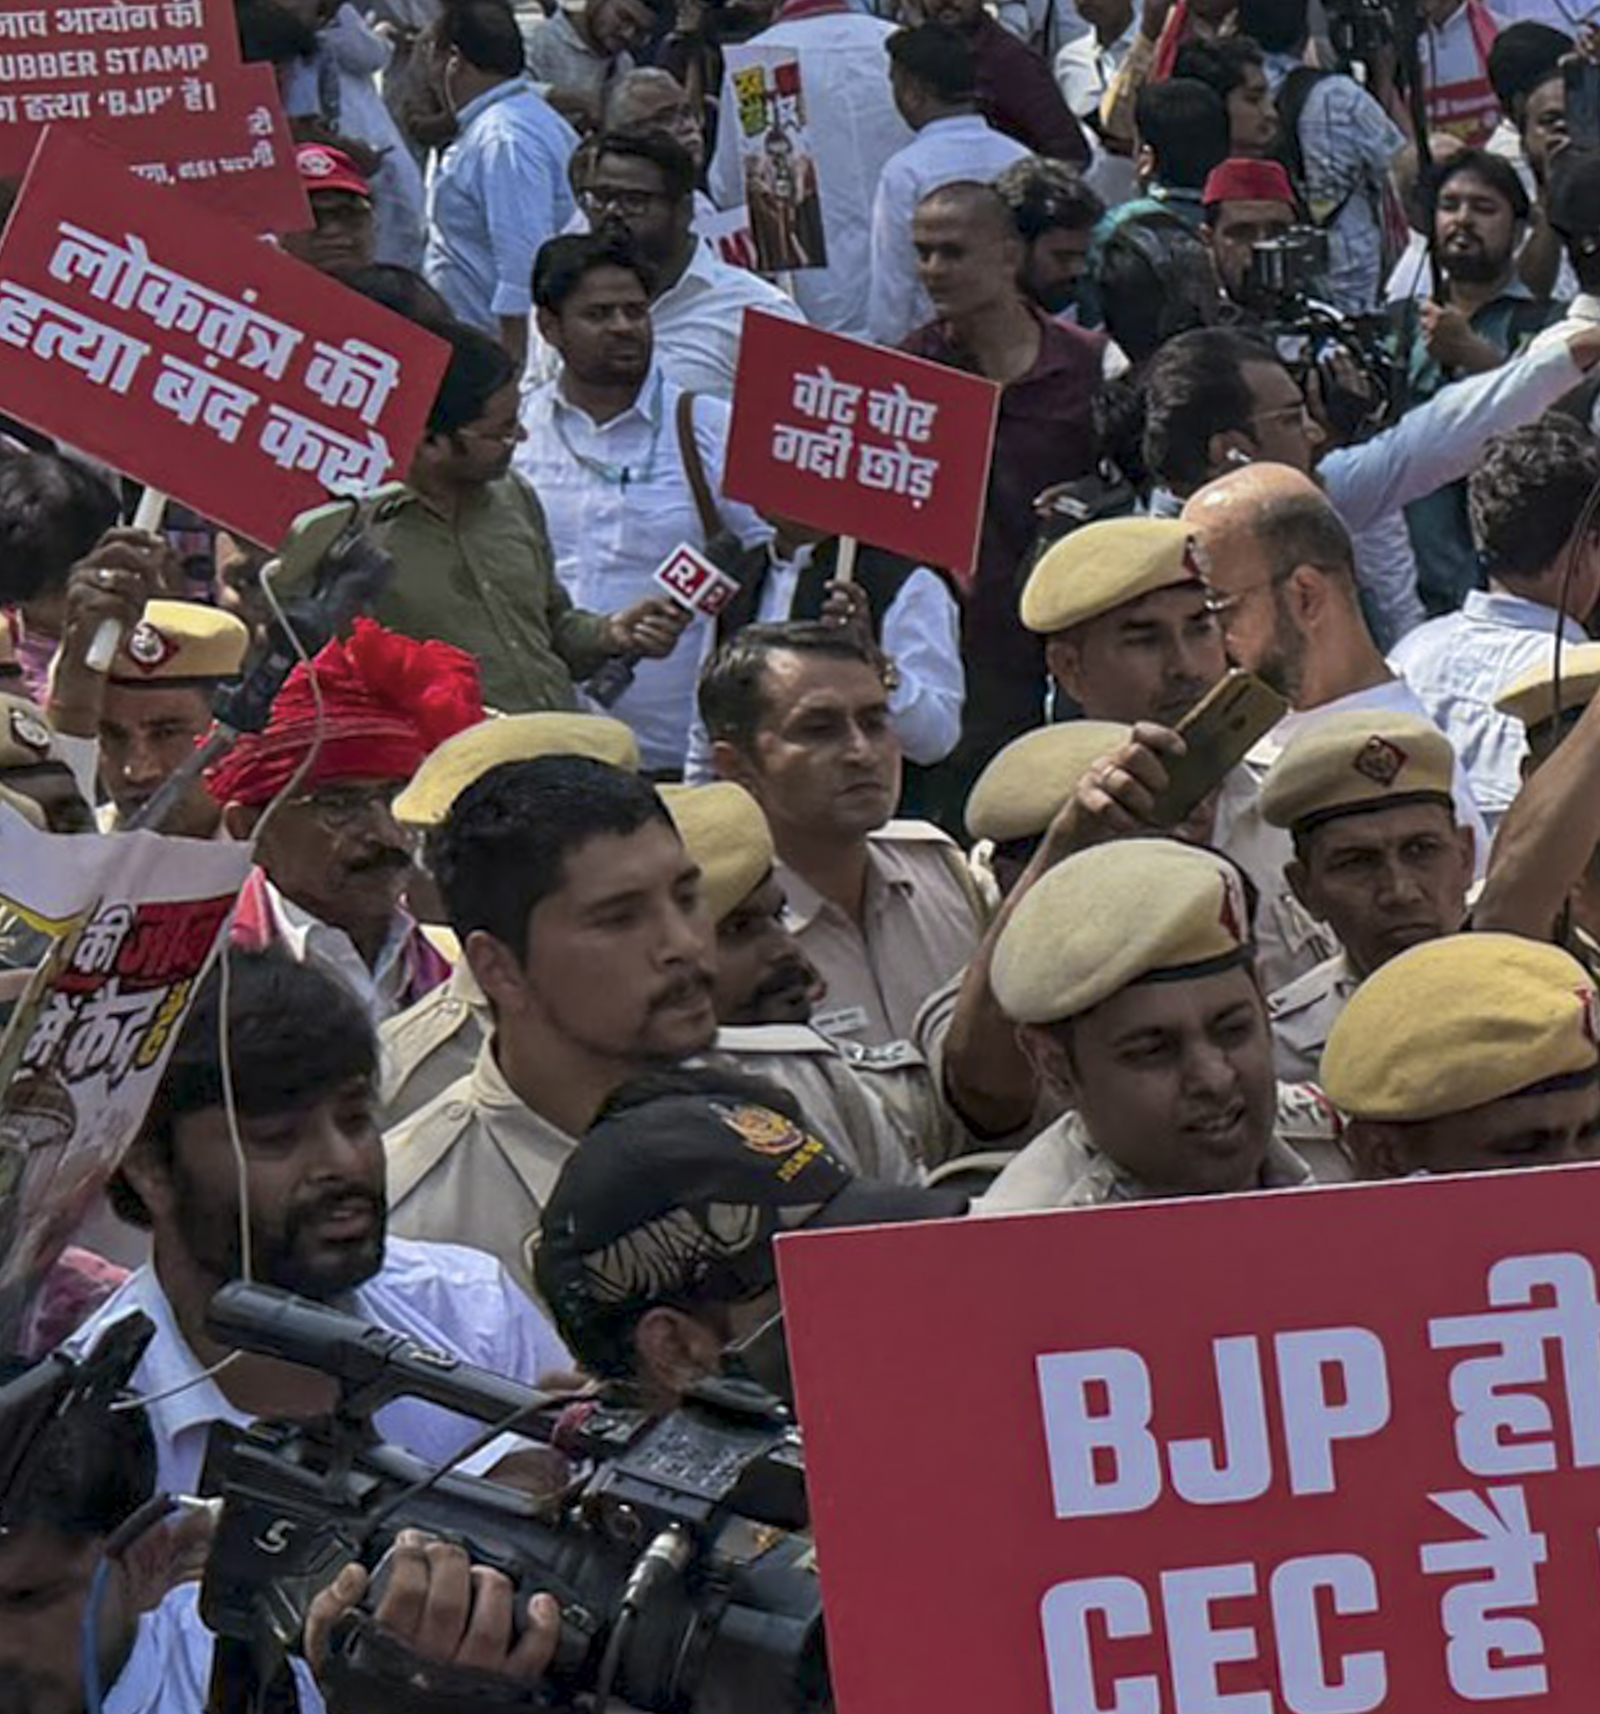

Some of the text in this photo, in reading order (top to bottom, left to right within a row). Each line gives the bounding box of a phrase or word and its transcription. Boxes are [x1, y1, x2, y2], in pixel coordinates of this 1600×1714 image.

[0, 44, 209, 81] UBBER STAMP
[56, 1, 158, 35] आयोग
[0, 279, 394, 493] हत्या बंद करो
[48, 221, 400, 424] लोकतंत्र की
[772, 424, 939, 509] गद्दी छोड़
[793, 366, 938, 442] वोट चोर
[1036, 1327, 1391, 1518] BJP
[1420, 1485, 1548, 1700] है
